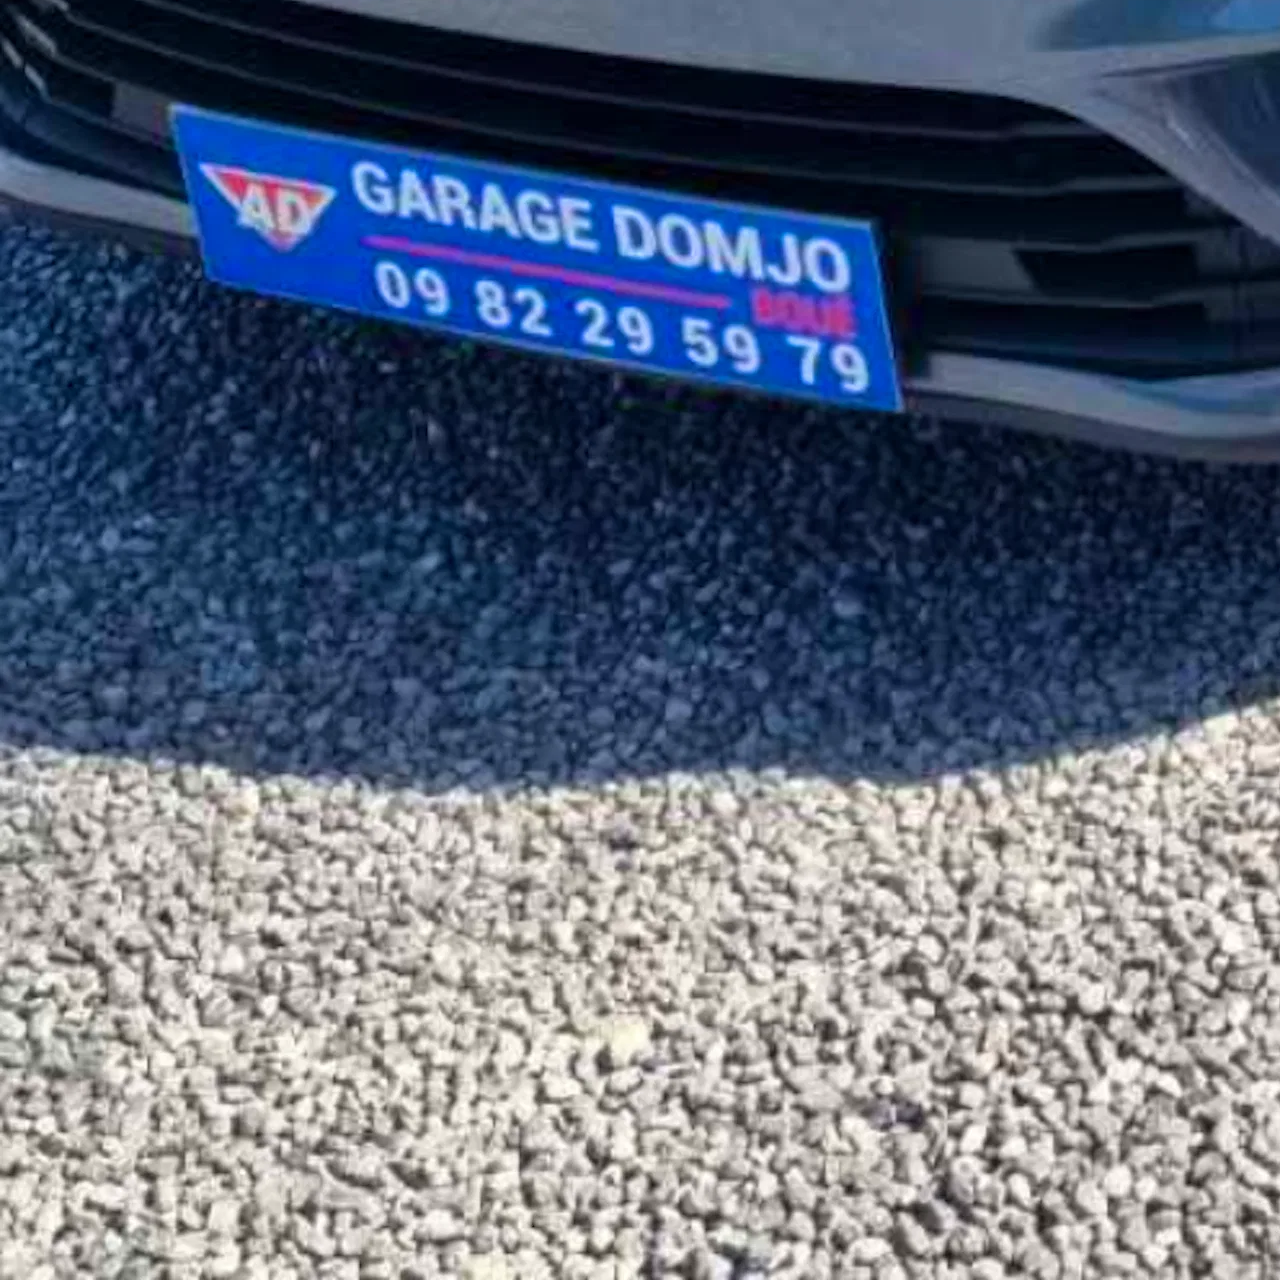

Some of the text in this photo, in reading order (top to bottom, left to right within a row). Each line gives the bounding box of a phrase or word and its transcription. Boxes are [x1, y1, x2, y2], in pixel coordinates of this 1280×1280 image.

[237, 182, 313, 235] AD
[351, 160, 851, 294] GARAGE DOMJO
[375, 261, 869, 394] 09 82 29 59 79
